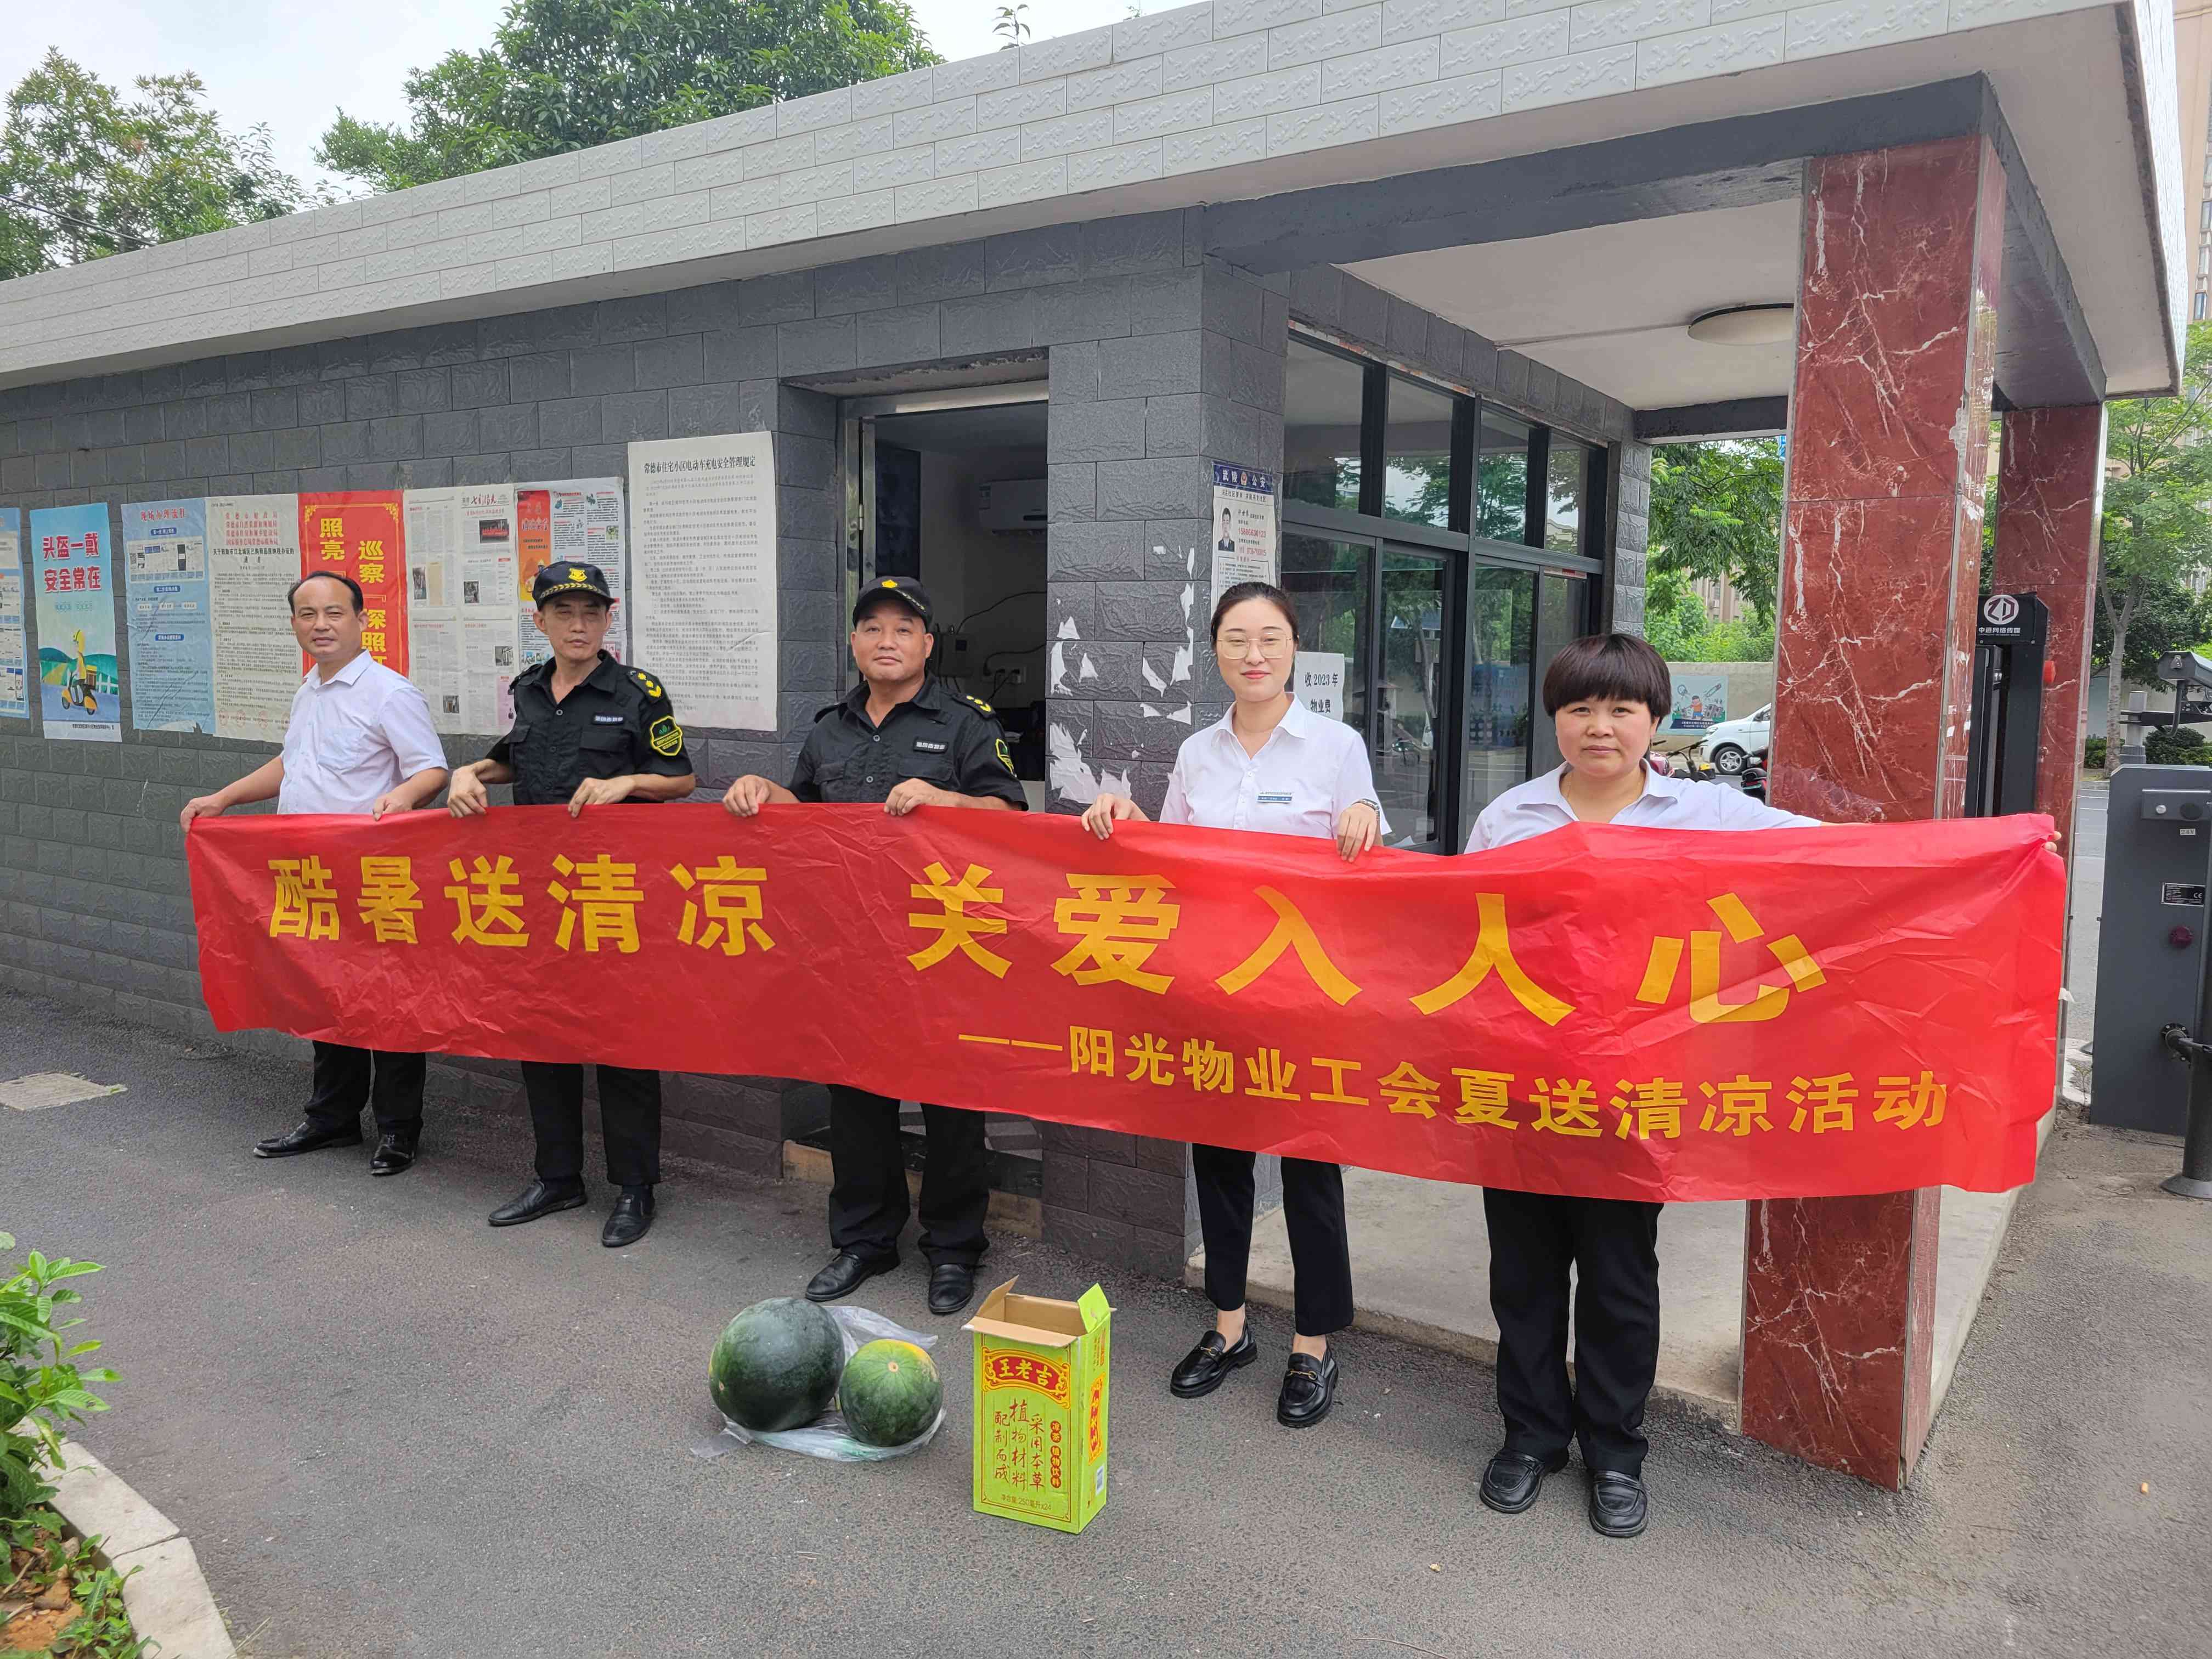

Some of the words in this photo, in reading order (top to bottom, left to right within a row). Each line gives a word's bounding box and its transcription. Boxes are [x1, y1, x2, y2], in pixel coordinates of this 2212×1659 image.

[644, 455, 755, 474] 常德市住宅小区电动车充电安全管理规定
[1223, 469, 1238, 483] 武陵
[1252, 474, 1265, 488] 公安
[42, 532, 99, 560] 头盔一戴
[44, 566, 102, 592] 安全常在
[1310, 699, 1330, 713] 物业费
[269, 854, 773, 956] 酷暑送清凉
[908, 862, 1827, 1025] 关爱入人心
[999, 1358, 1053, 1386] 王老吉
[995, 1410, 1010, 1483] 配制而成
[1009, 1397, 1029, 1492] 植物材料
[1029, 1413, 1045, 1493] 采用本草
[1051, 1446, 1061, 1487] 植物饮料
